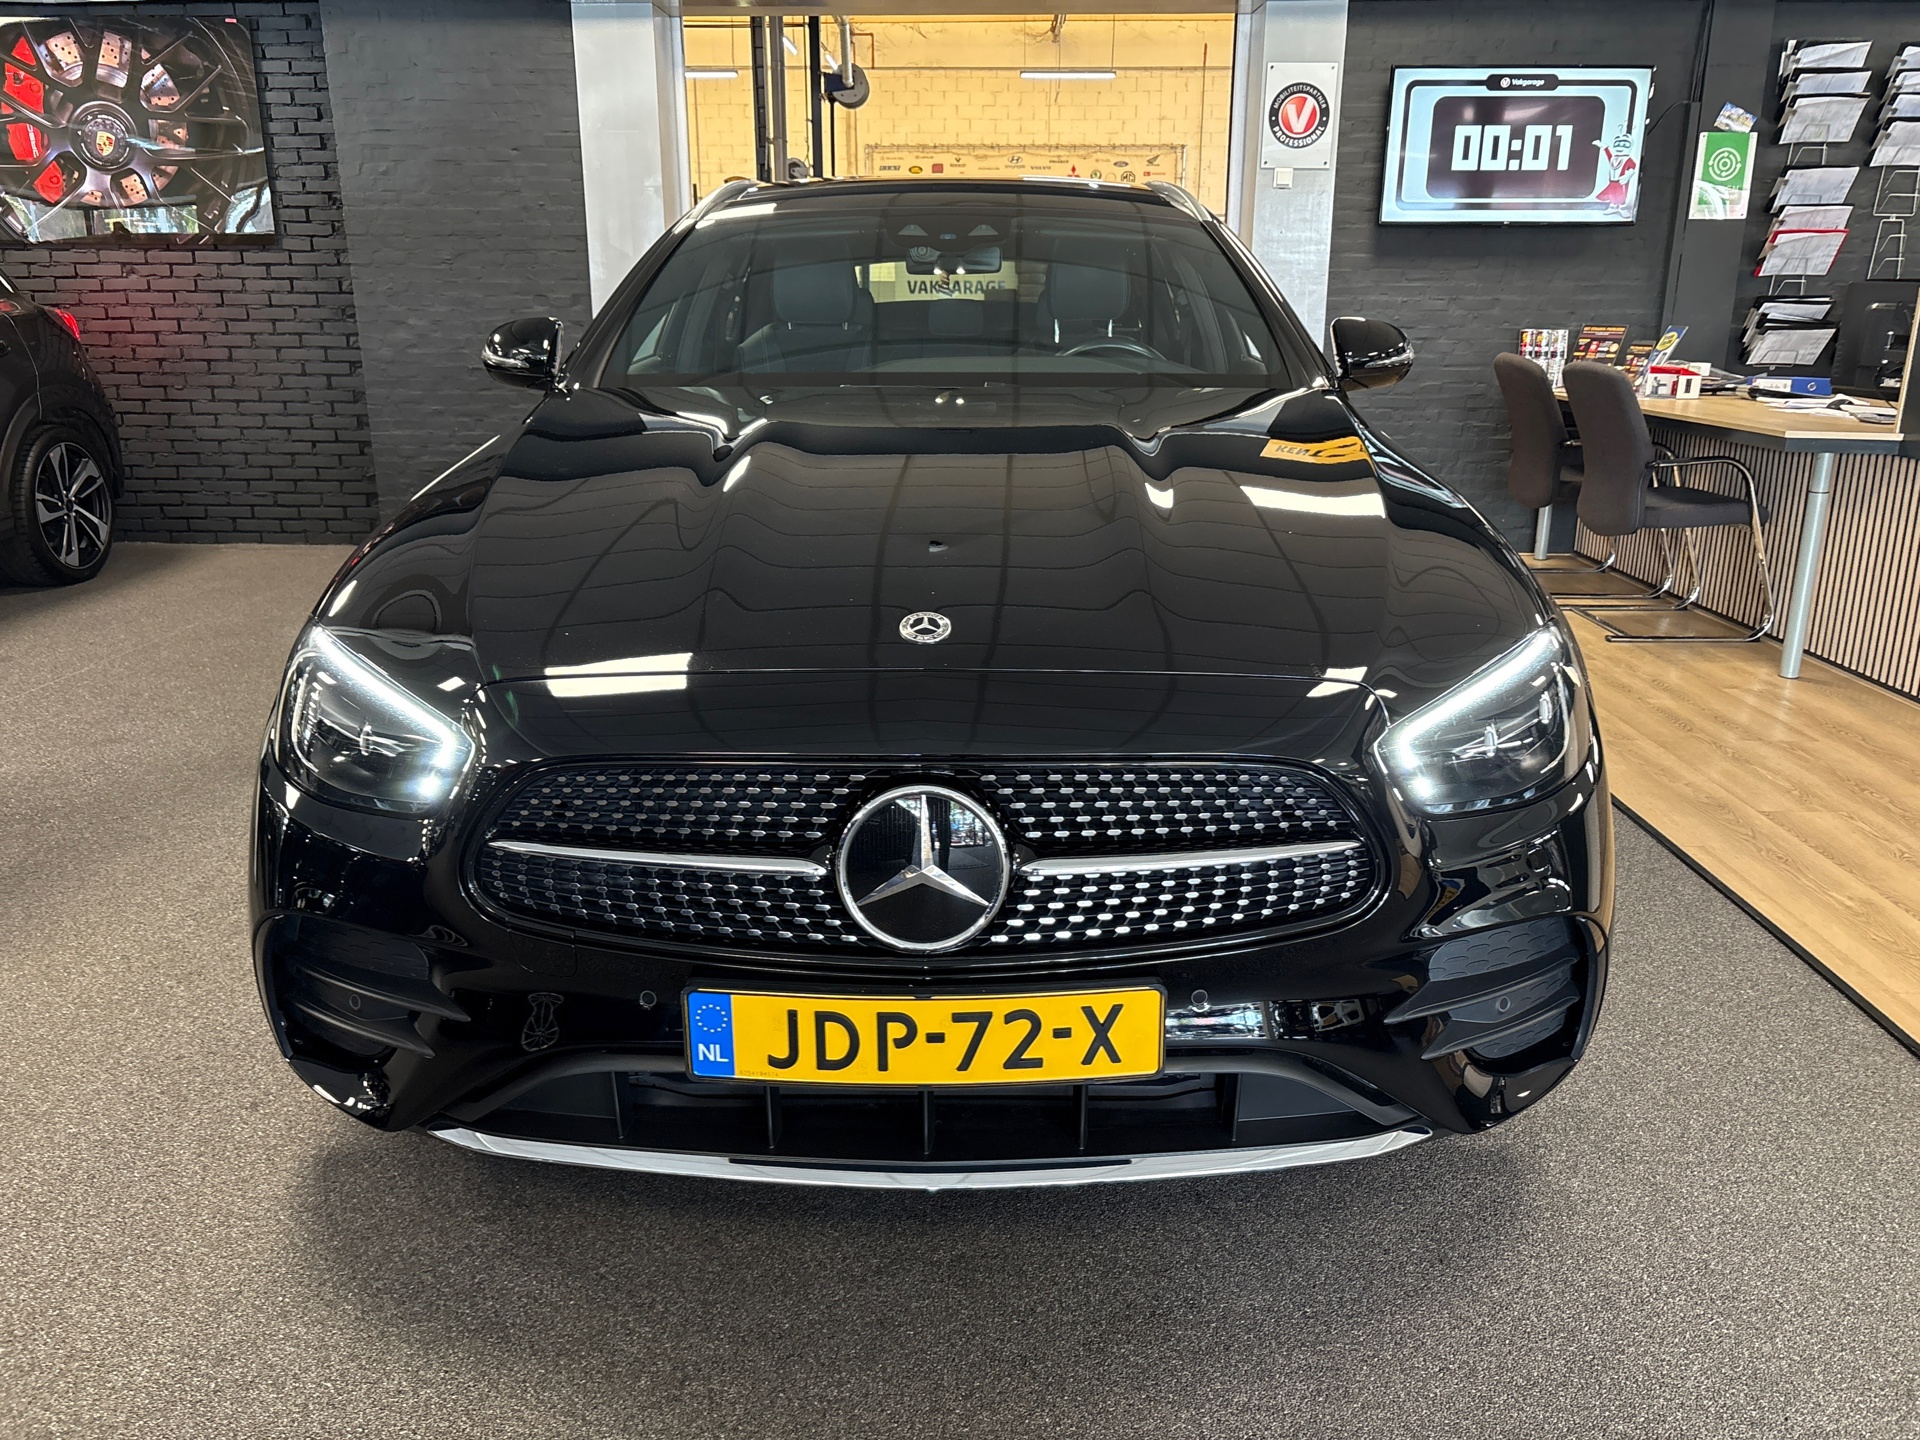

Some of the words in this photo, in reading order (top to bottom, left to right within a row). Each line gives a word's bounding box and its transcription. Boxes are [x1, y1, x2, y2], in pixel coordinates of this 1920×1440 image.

[1273, 84, 1327, 109] MOBILITEITSPARTNER
[1273, 126, 1325, 147] PROFESSIONAL
[1451, 124, 1573, 171] 00:01
[907, 280, 1006, 294] VAKARAGE
[768, 1003, 1124, 1072] JDP-72-X
[698, 1043, 729, 1063] NL
